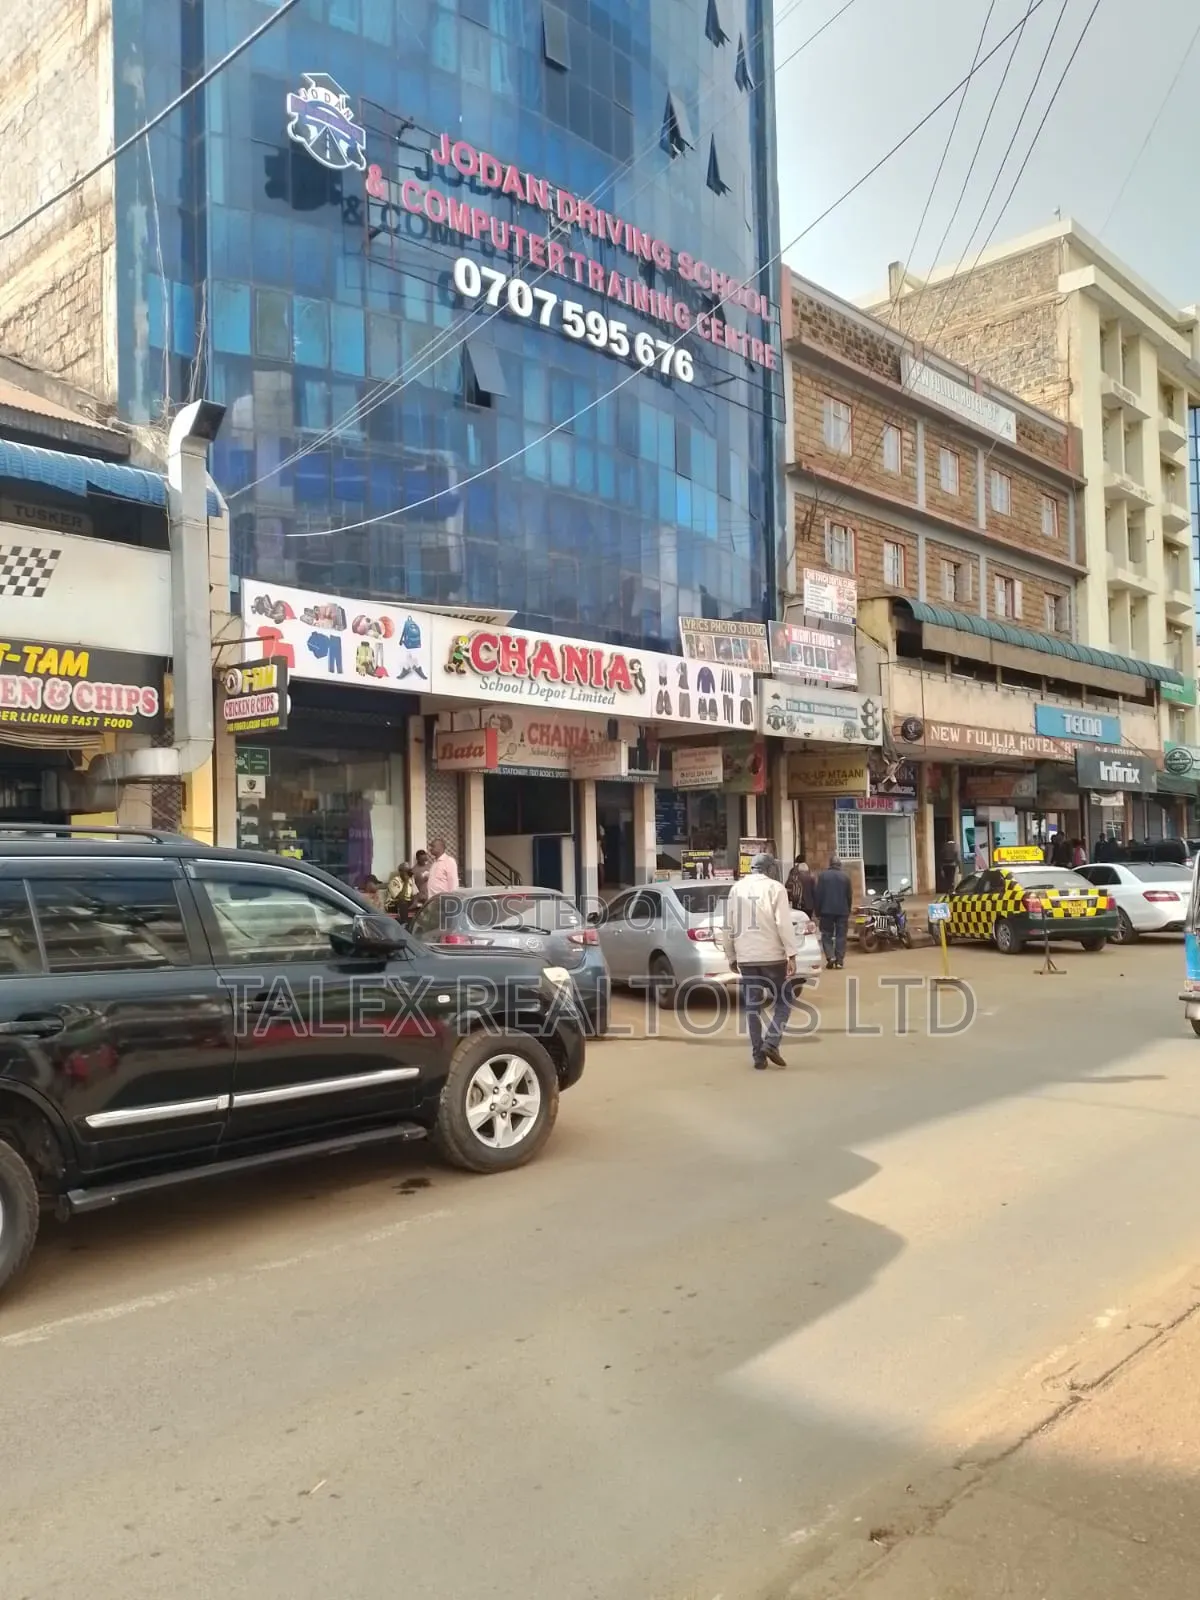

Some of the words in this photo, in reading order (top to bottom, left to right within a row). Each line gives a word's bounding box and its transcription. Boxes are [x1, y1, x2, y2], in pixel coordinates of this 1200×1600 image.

[302, 87, 351, 119] JODAN
[431, 134, 549, 210] JODAN
[556, 188, 673, 270] DRIVING
[677, 250, 775, 323] SCHOOL
[365, 163, 386, 199] &
[402, 179, 566, 274] COMPUTER
[569, 253, 690, 332] TRAINING
[695, 311, 778, 371] CENTRE
[453, 256, 558, 327] 0707
[562, 299, 630, 358] 595
[634, 331, 694, 383] 676
[13, 504, 83, 529] TUSKER
[683, 619, 708, 632] LYRICS
[710, 621, 736, 634] PHOTO
[738, 623, 765, 636] STUDIO
[470, 632, 634, 693] CHANIA
[43, 678, 73, 711] &
[72, 680, 159, 718] CHIPS
[479, 675, 525, 696] School
[527, 681, 567, 703] Depot
[568, 687, 617, 706] Limited
[224, 697, 251, 718] CHICKEN
[256, 694, 275, 713] CHIPS
[20, 711, 68, 725] LICKING
[71, 715, 100, 727] FAST
[103, 717, 134, 730] FOOD
[527, 722, 592, 748] CHANIA
[931, 725, 960, 743] NEW
[966, 729, 1015, 749] FULILIA
[1019, 736, 1059, 755] HOTEL
[440, 742, 486, 762] Bata
[827, 768, 864, 780] MTAANI
[1099, 760, 1141, 784] Infinix
